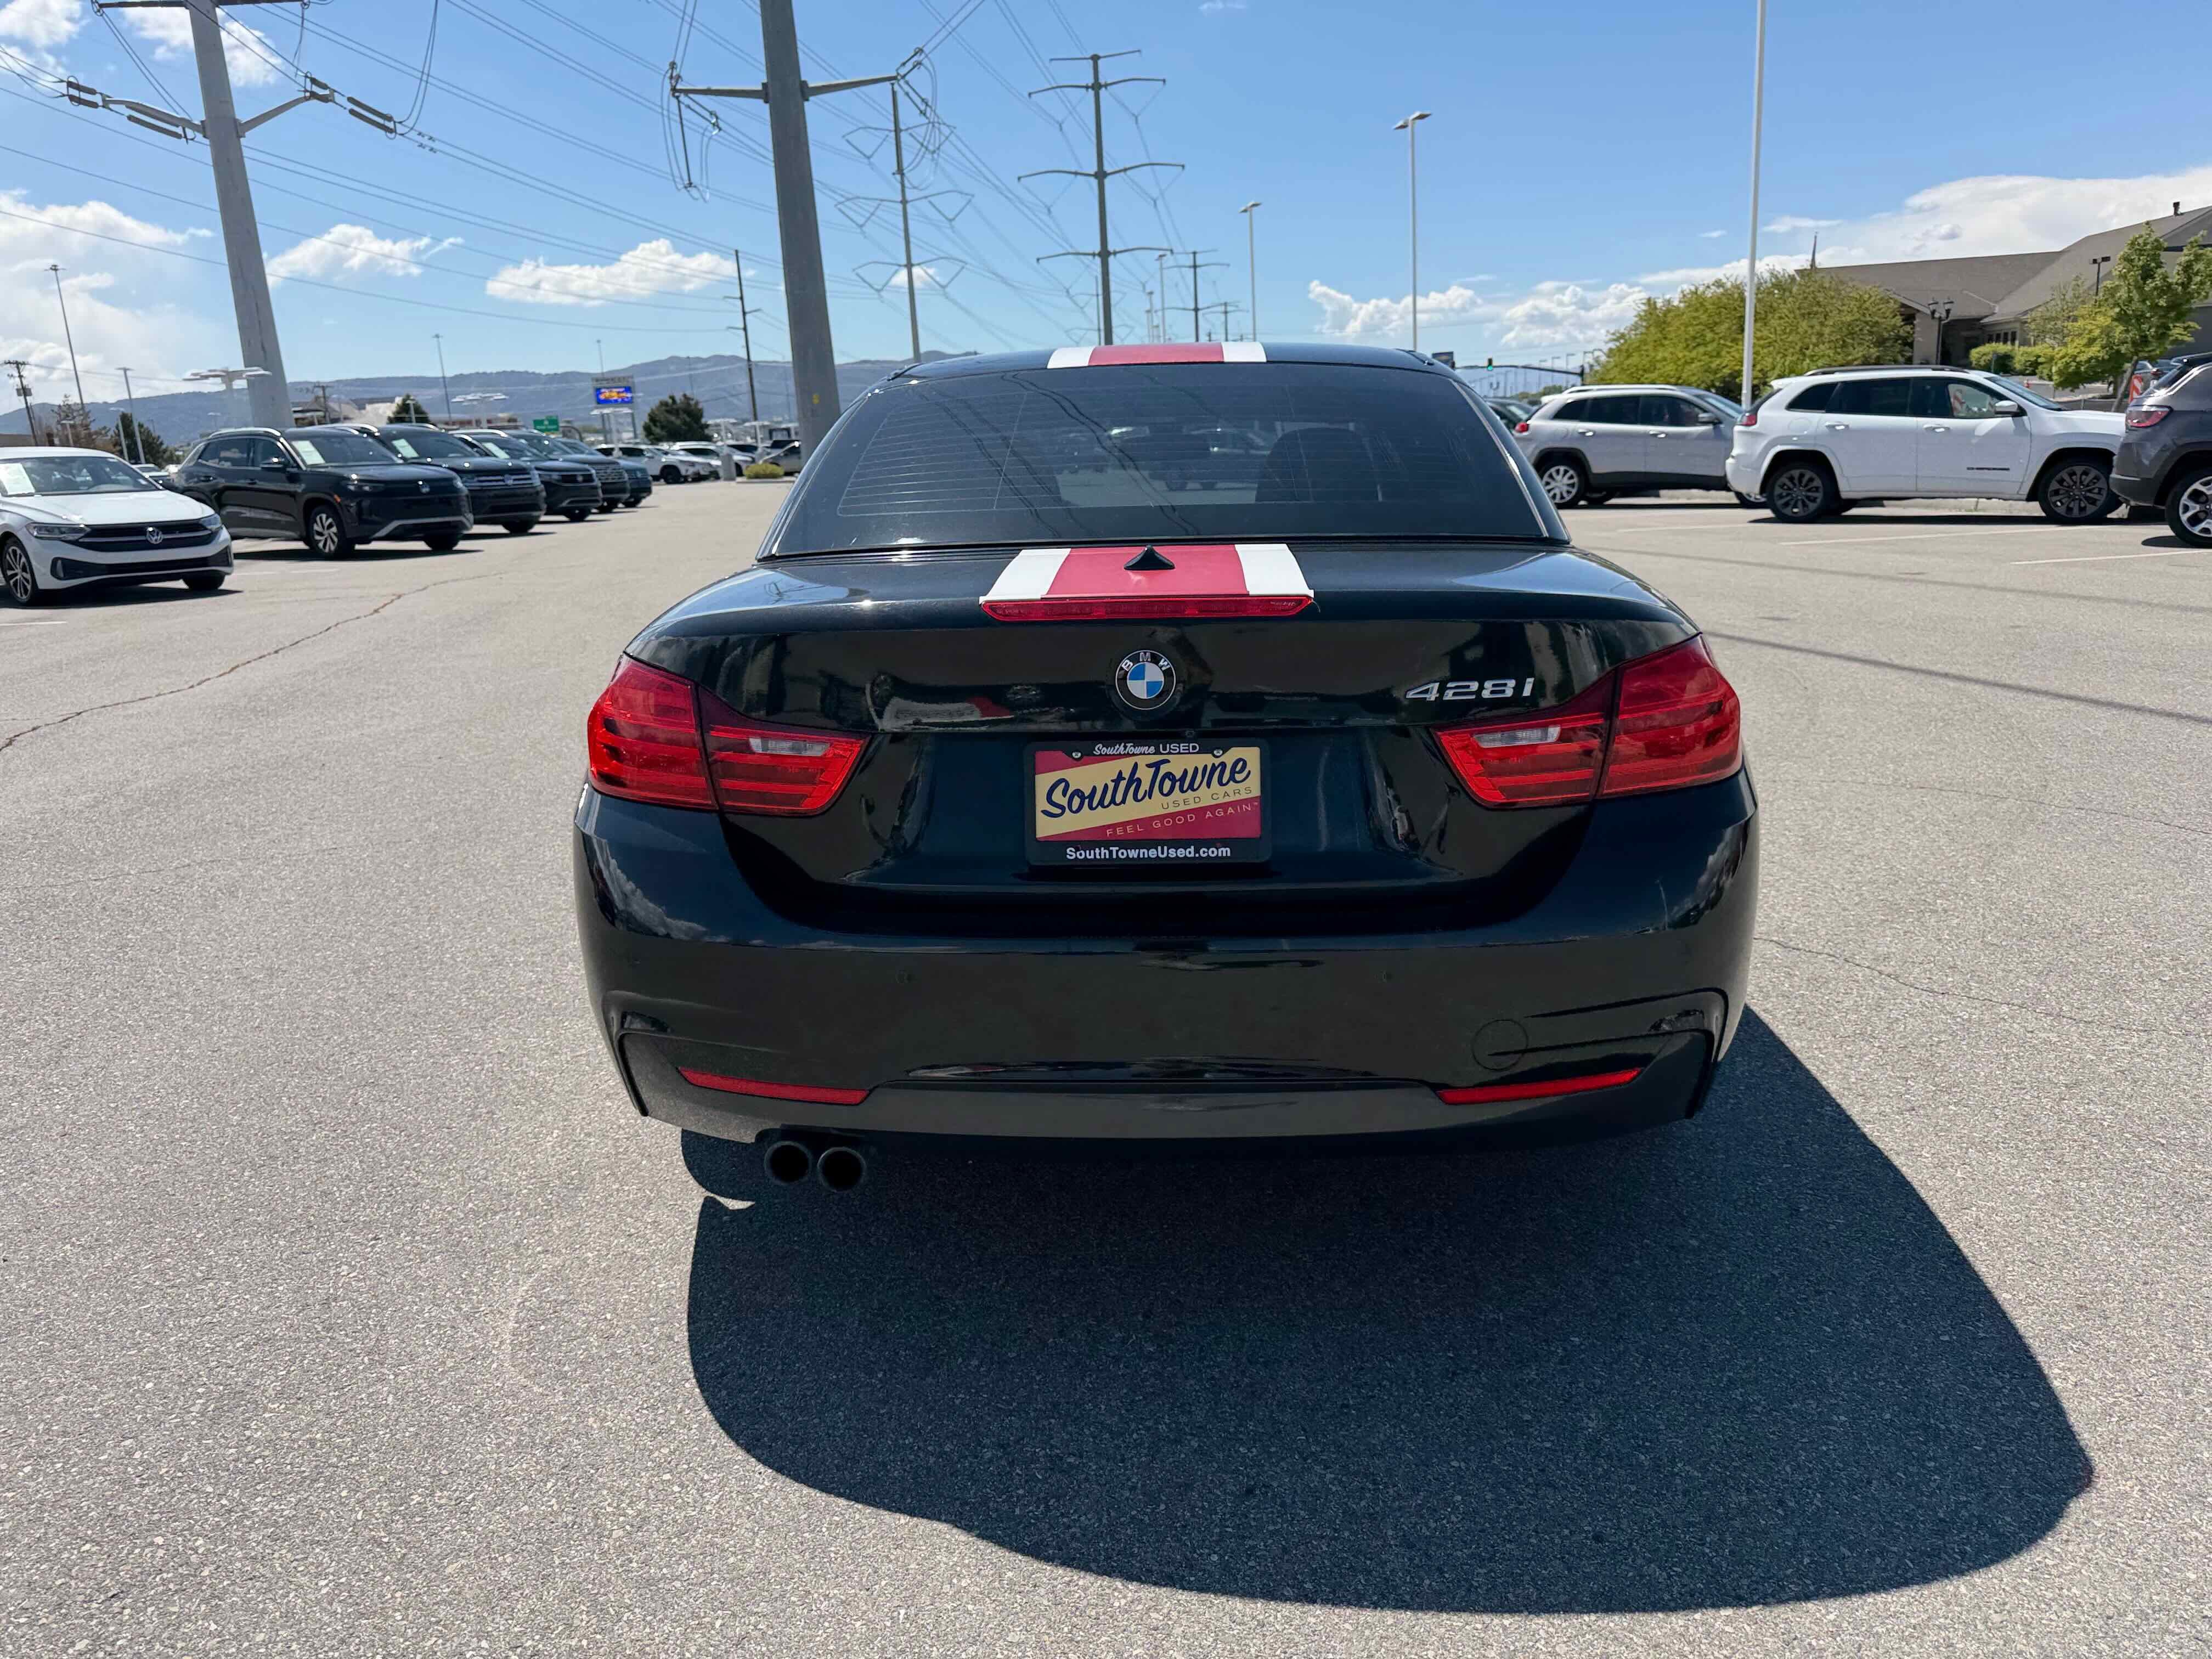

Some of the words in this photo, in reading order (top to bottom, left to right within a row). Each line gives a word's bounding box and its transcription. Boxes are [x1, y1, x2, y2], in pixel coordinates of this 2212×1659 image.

[1121, 652, 1171, 672] BMW
[1093, 743, 1155, 755] SouthTowne
[1160, 743, 1199, 754] USED
[1040, 757, 1251, 819] SouthTowne
[1161, 796, 1201, 810] USED
[1211, 786, 1252, 800] CARS
[1106, 824, 1145, 837] FEEL
[1153, 814, 1196, 828] GOOD
[1066, 845, 1231, 860] SouthTowneUsed.com
